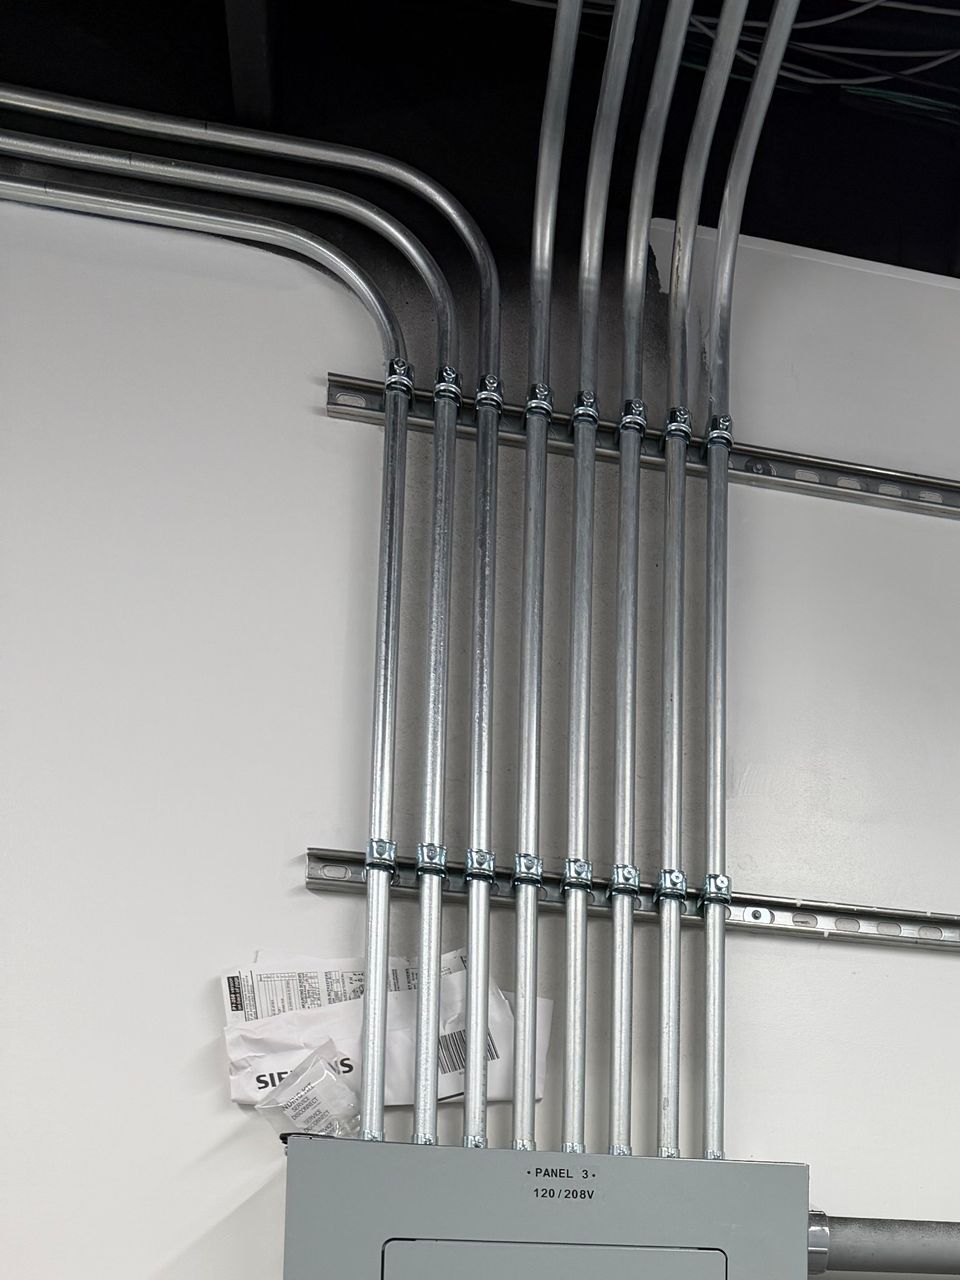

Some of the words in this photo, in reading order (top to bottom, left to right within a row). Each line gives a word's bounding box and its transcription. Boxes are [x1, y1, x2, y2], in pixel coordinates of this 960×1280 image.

[536, 1168, 573, 1178] PANEL
[582, 1170, 588, 1179] 3
[534, 1188, 594, 1199] 120/208V
